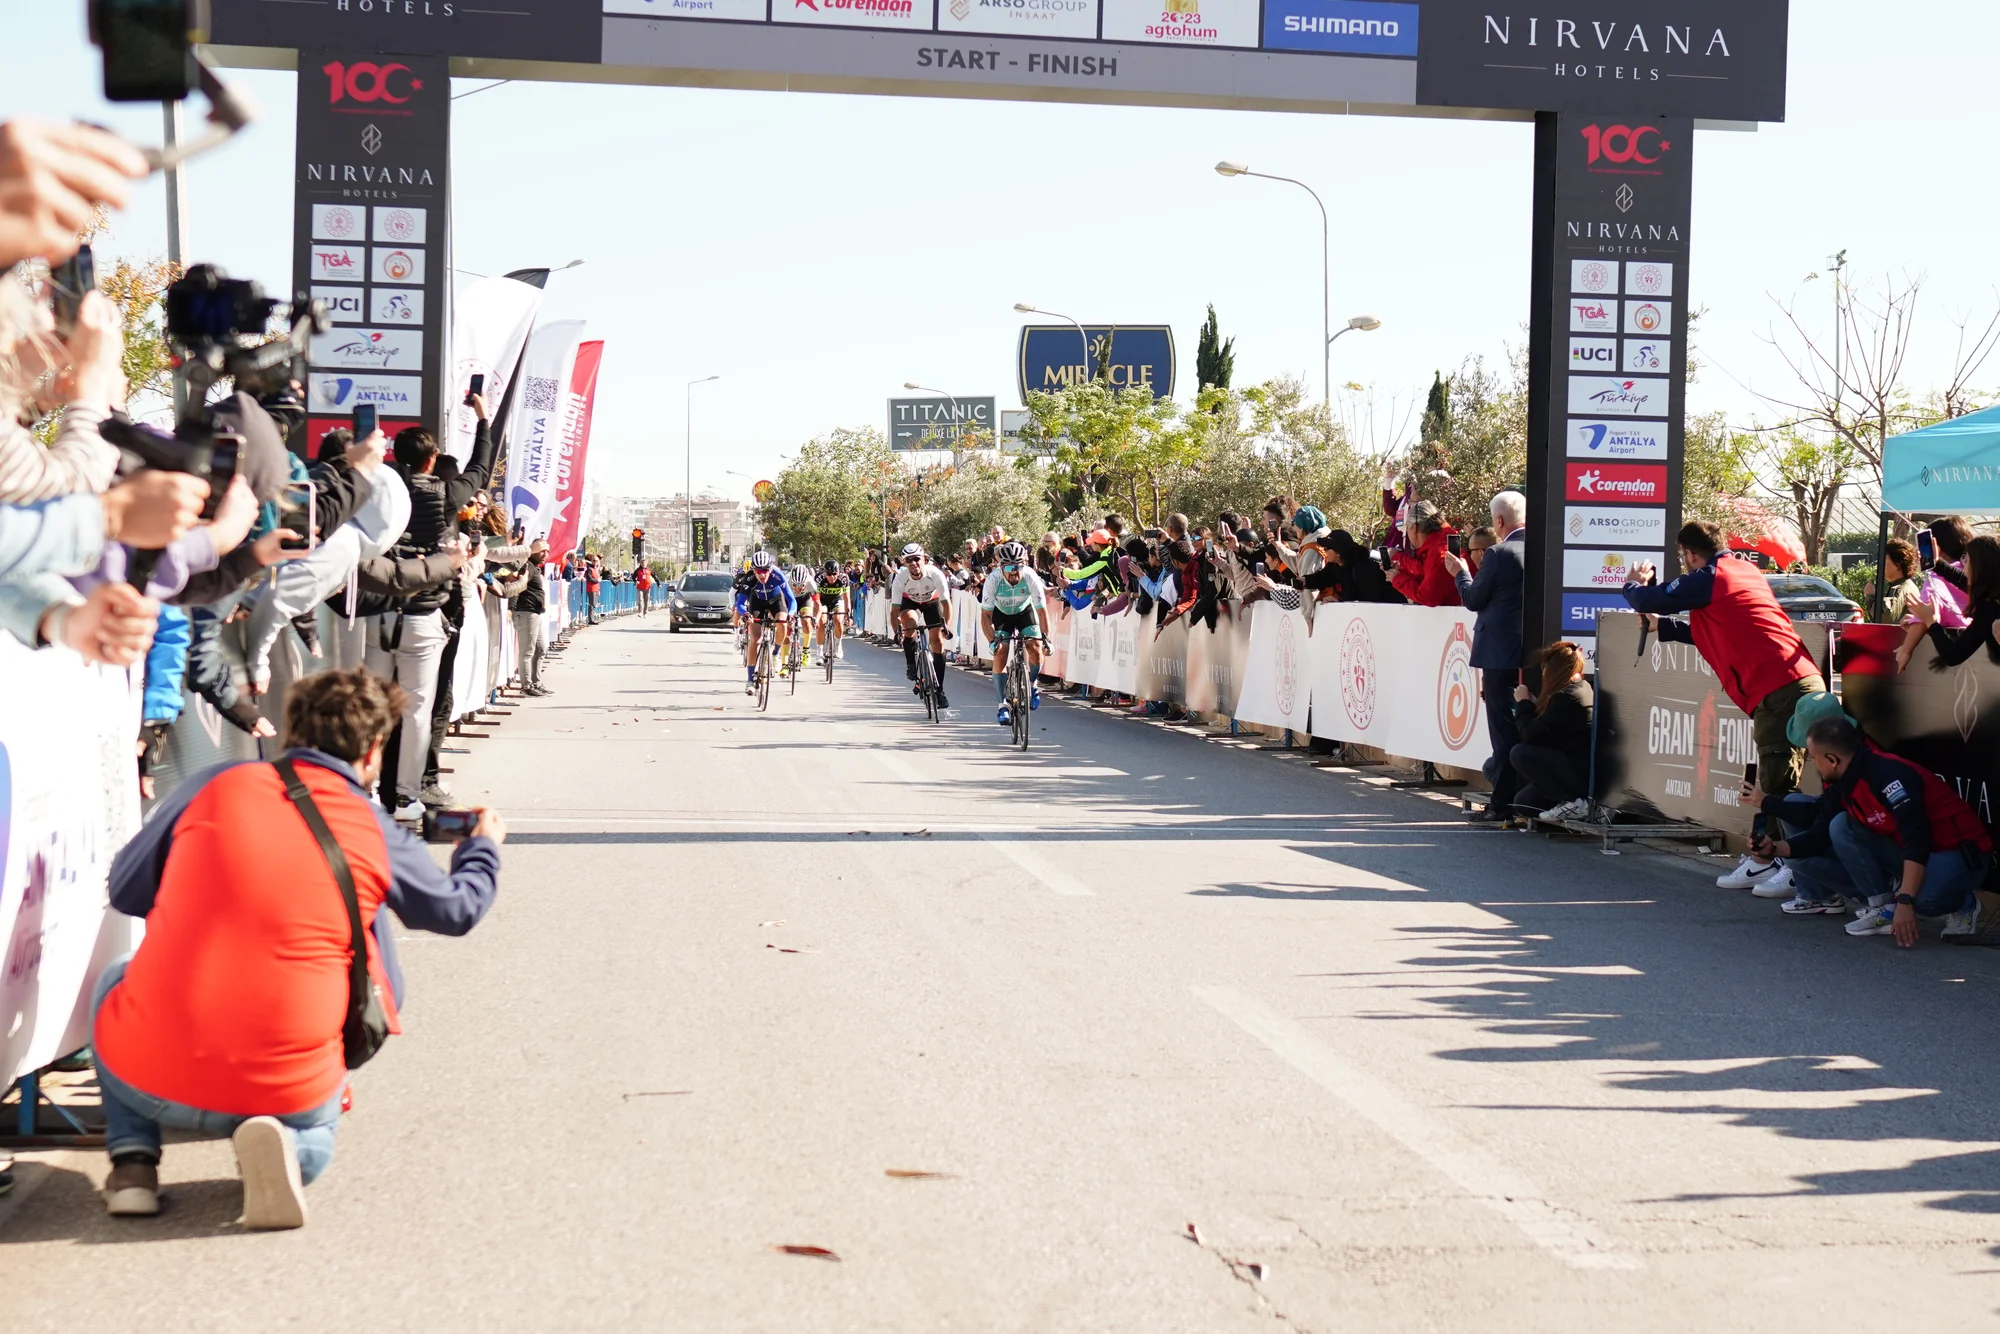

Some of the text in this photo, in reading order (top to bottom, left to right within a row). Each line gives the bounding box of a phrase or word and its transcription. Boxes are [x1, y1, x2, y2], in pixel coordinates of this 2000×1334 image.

[337, 0, 454, 17] HOTELS
[673, 0, 714, 10] Airport
[823, 0, 913, 12] corendon
[979, 0, 1087, 12] ARSO GROUP
[1144, 24, 1218, 38] agtohum
[1284, 14, 1399, 37] SHIMANO
[1484, 14, 1731, 57] NIRVANA
[916, 47, 1001, 71] START
[1028, 53, 1118, 77] FINISH
[1554, 63, 1660, 81] HOTELS
[307, 163, 434, 186] NIRVANA
[342, 188, 398, 199] HOTELS
[1566, 221, 1680, 242] NIRVANA
[1598, 245, 1647, 254] HOTELS
[314, 249, 356, 271] TGA
[1572, 302, 1609, 323] TGA
[332, 342, 400, 367] Türkiye
[1580, 347, 1613, 361] UCI
[355, 391, 409, 402] ANTALYA
[1588, 389, 1649, 414] Türkiye
[896, 402, 987, 421] TITANIC
[556, 391, 582, 491] corendon
[1608, 436, 1656, 446] ANTALYA
[528, 417, 546, 484] ANTALYA
[1608, 446, 1636, 455] Airport
[541, 448, 553, 484] Airport
[1932, 465, 2000, 483] NIRVANA
[1596, 478, 1655, 492] corendon
[1588, 518, 1661, 528] ARSO GROUP
[1732, 551, 1760, 563] ONE
[1591, 574, 1627, 585] agtohu
[1150, 656, 1184, 679] NIRVANA
[1649, 705, 1760, 768] GRAN FOND
[1665, 778, 1741, 808] ANTALYA TÜRKİYE
[1886, 782, 1901, 794] UCI
